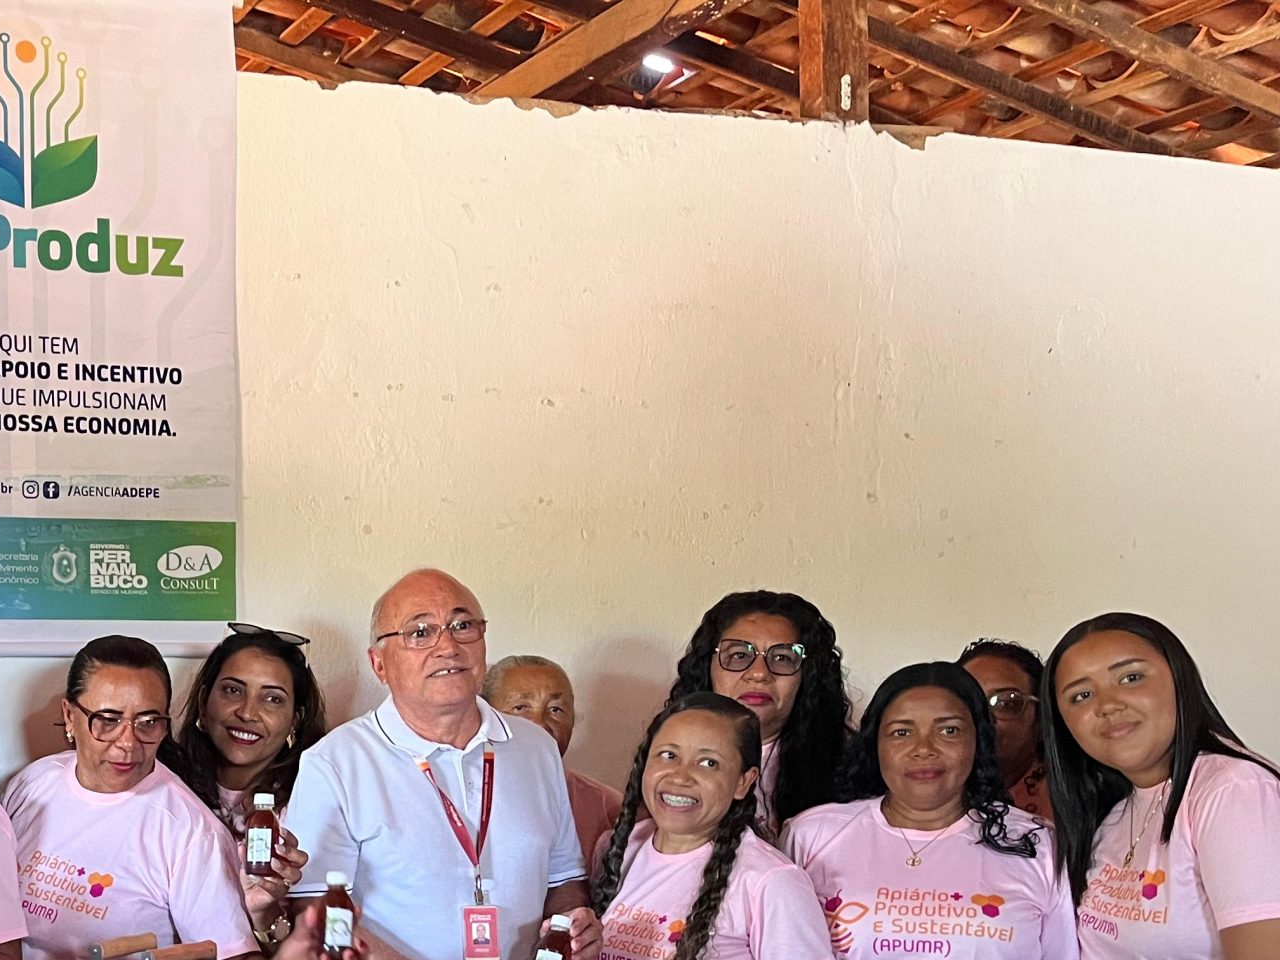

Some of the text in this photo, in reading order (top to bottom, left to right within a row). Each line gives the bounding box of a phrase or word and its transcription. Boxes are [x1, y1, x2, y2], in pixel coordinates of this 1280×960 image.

[38, 336, 79, 355] TEM
[57, 363, 68, 380] E
[75, 363, 182, 385] INCENTIVO
[33, 389, 166, 411] IMPULSIONAM
[63, 416, 177, 437] ECONOMIA.
[90, 550, 130, 563] PER
[166, 552, 213, 571] D&A
[90, 563, 136, 575] NAM
[91, 575, 148, 588] BUCO
[21, 864, 87, 895] Produtivo
[25, 882, 108, 920] Sustentável
[874, 902, 977, 918] Produtivo
[1092, 895, 1168, 924] Sustentável
[892, 918, 1014, 943] Sustentável
[873, 937, 951, 958] (APUMR)
